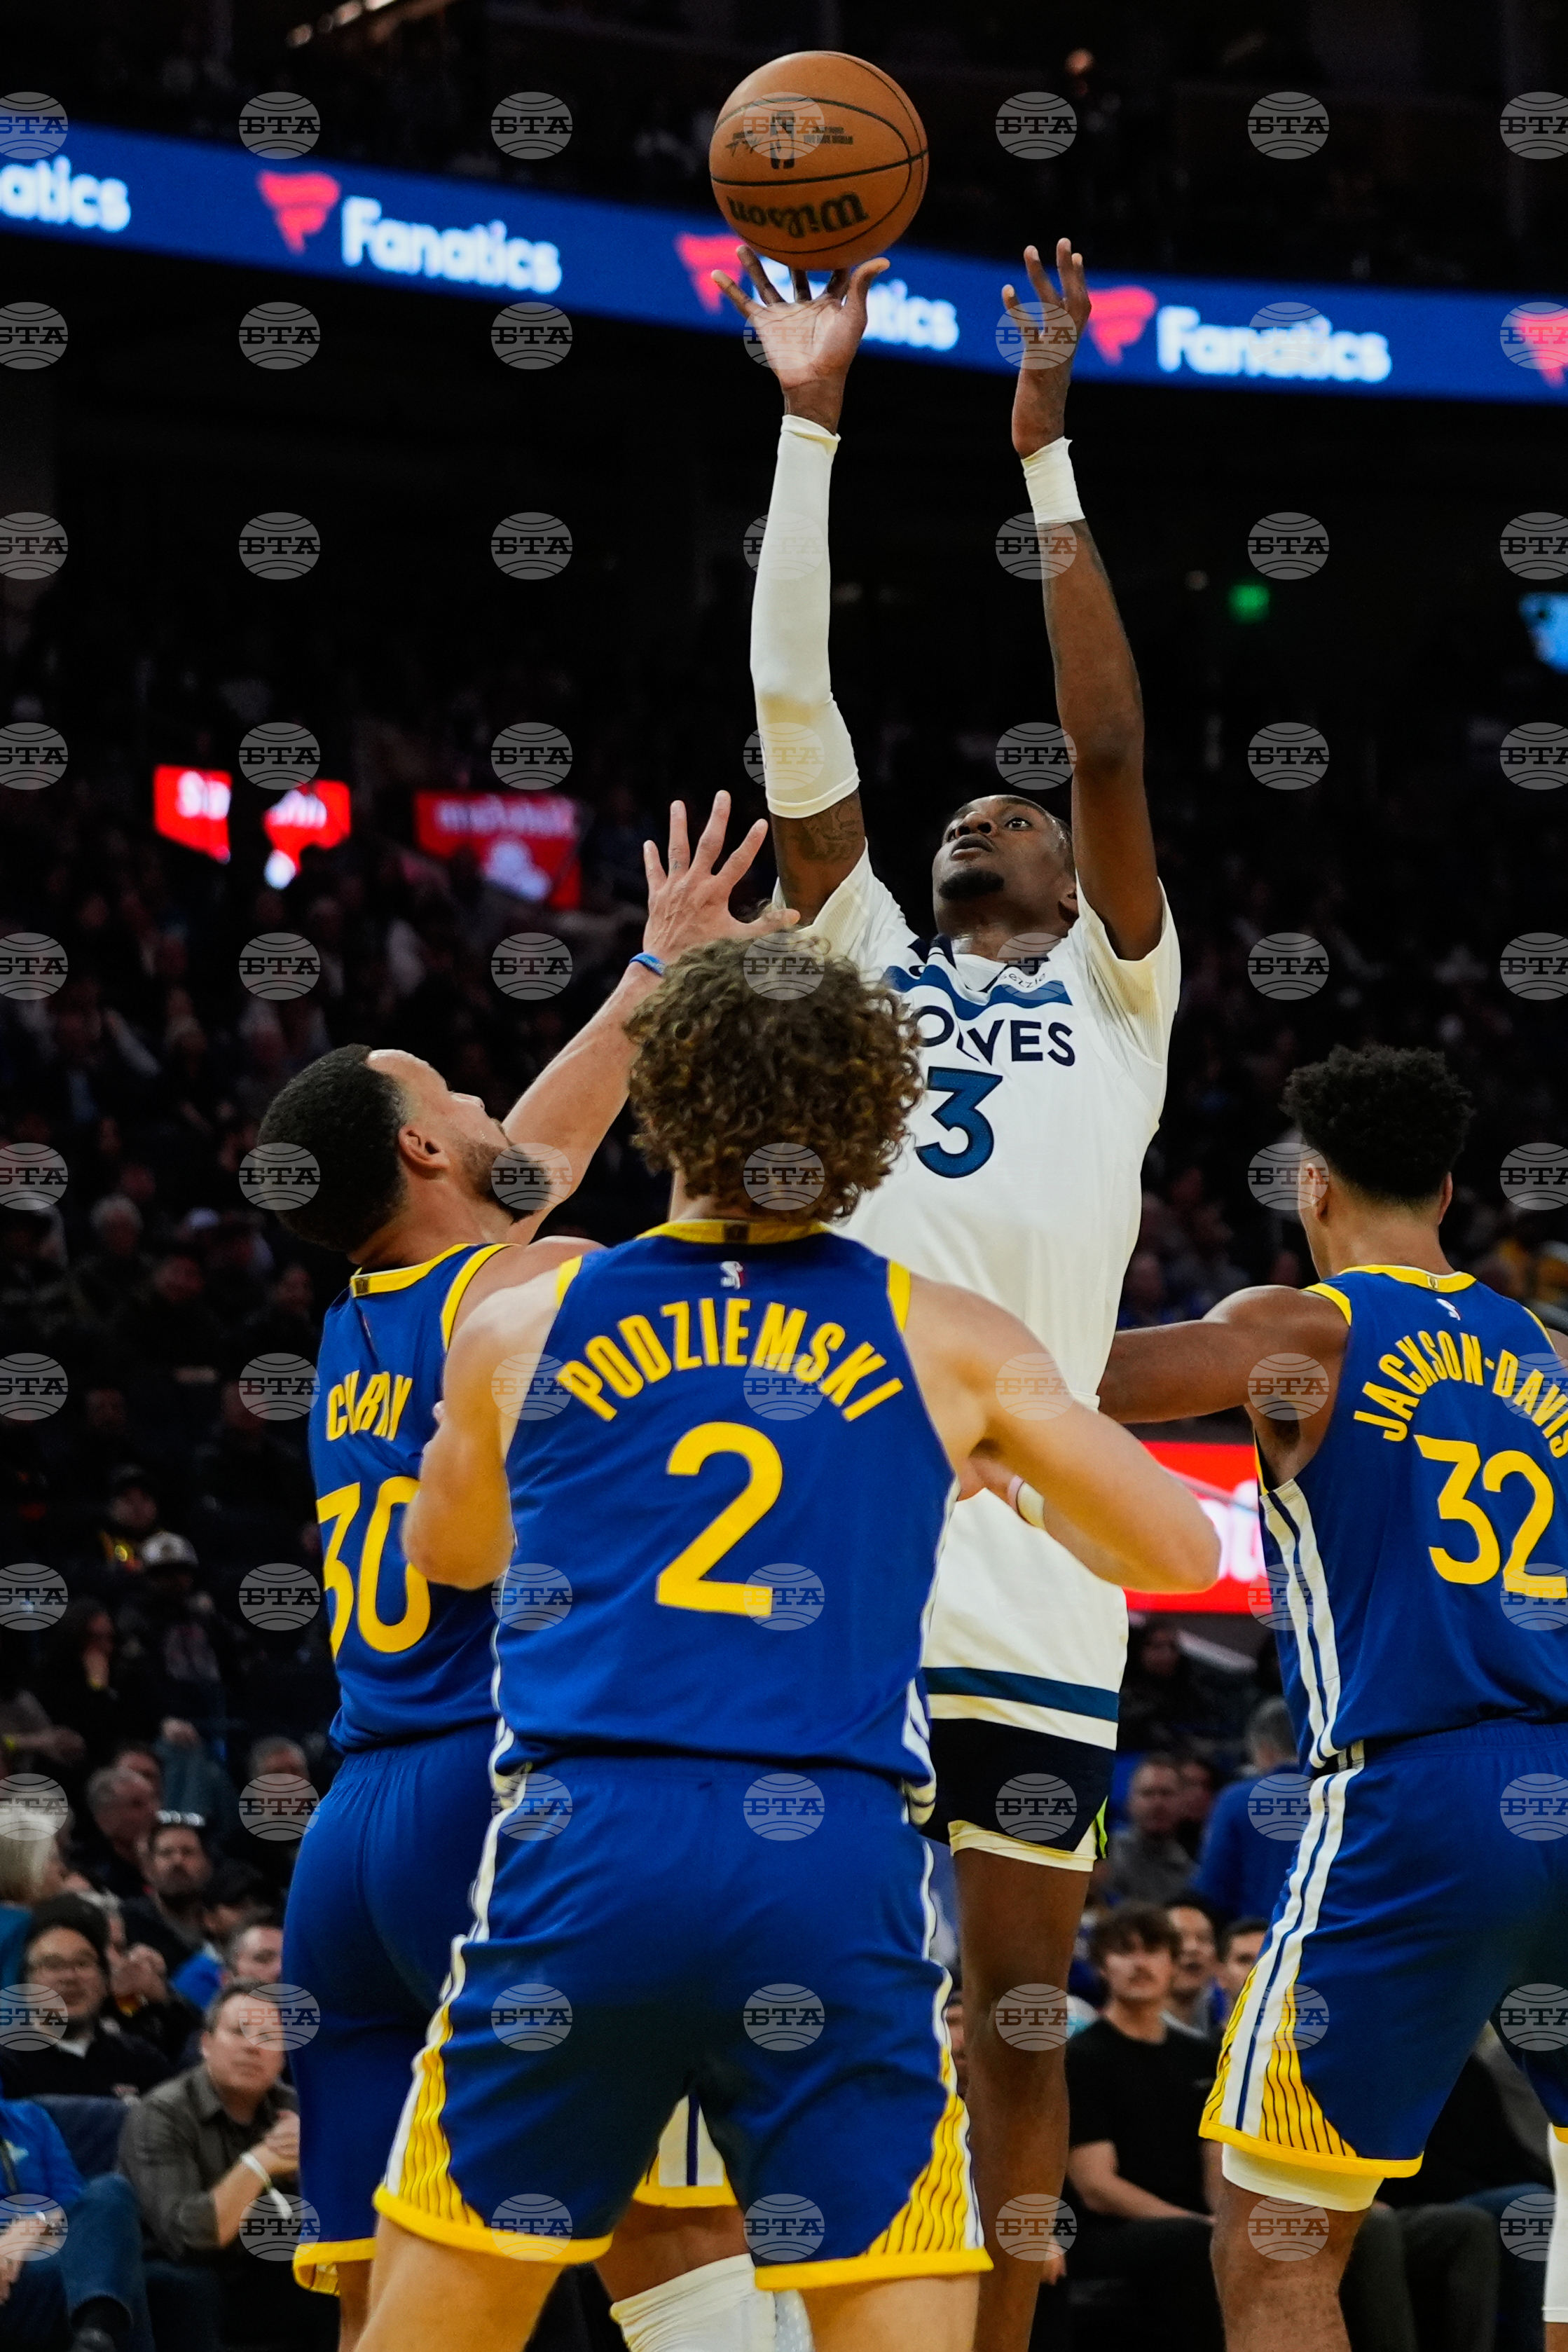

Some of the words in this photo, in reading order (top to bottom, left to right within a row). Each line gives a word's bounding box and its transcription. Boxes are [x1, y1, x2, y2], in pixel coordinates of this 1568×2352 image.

[0, 154, 131, 233] atics
[341, 195, 562, 294] Fanatics
[726, 191, 870, 238] Wilson
[1156, 305, 1393, 383] Fanatics
[915, 1066, 1003, 1178] 3
[555, 1297, 904, 1422] PODZIEMSKI
[655, 1420, 784, 1618] 2
[1412, 1433, 1568, 1600] 32
